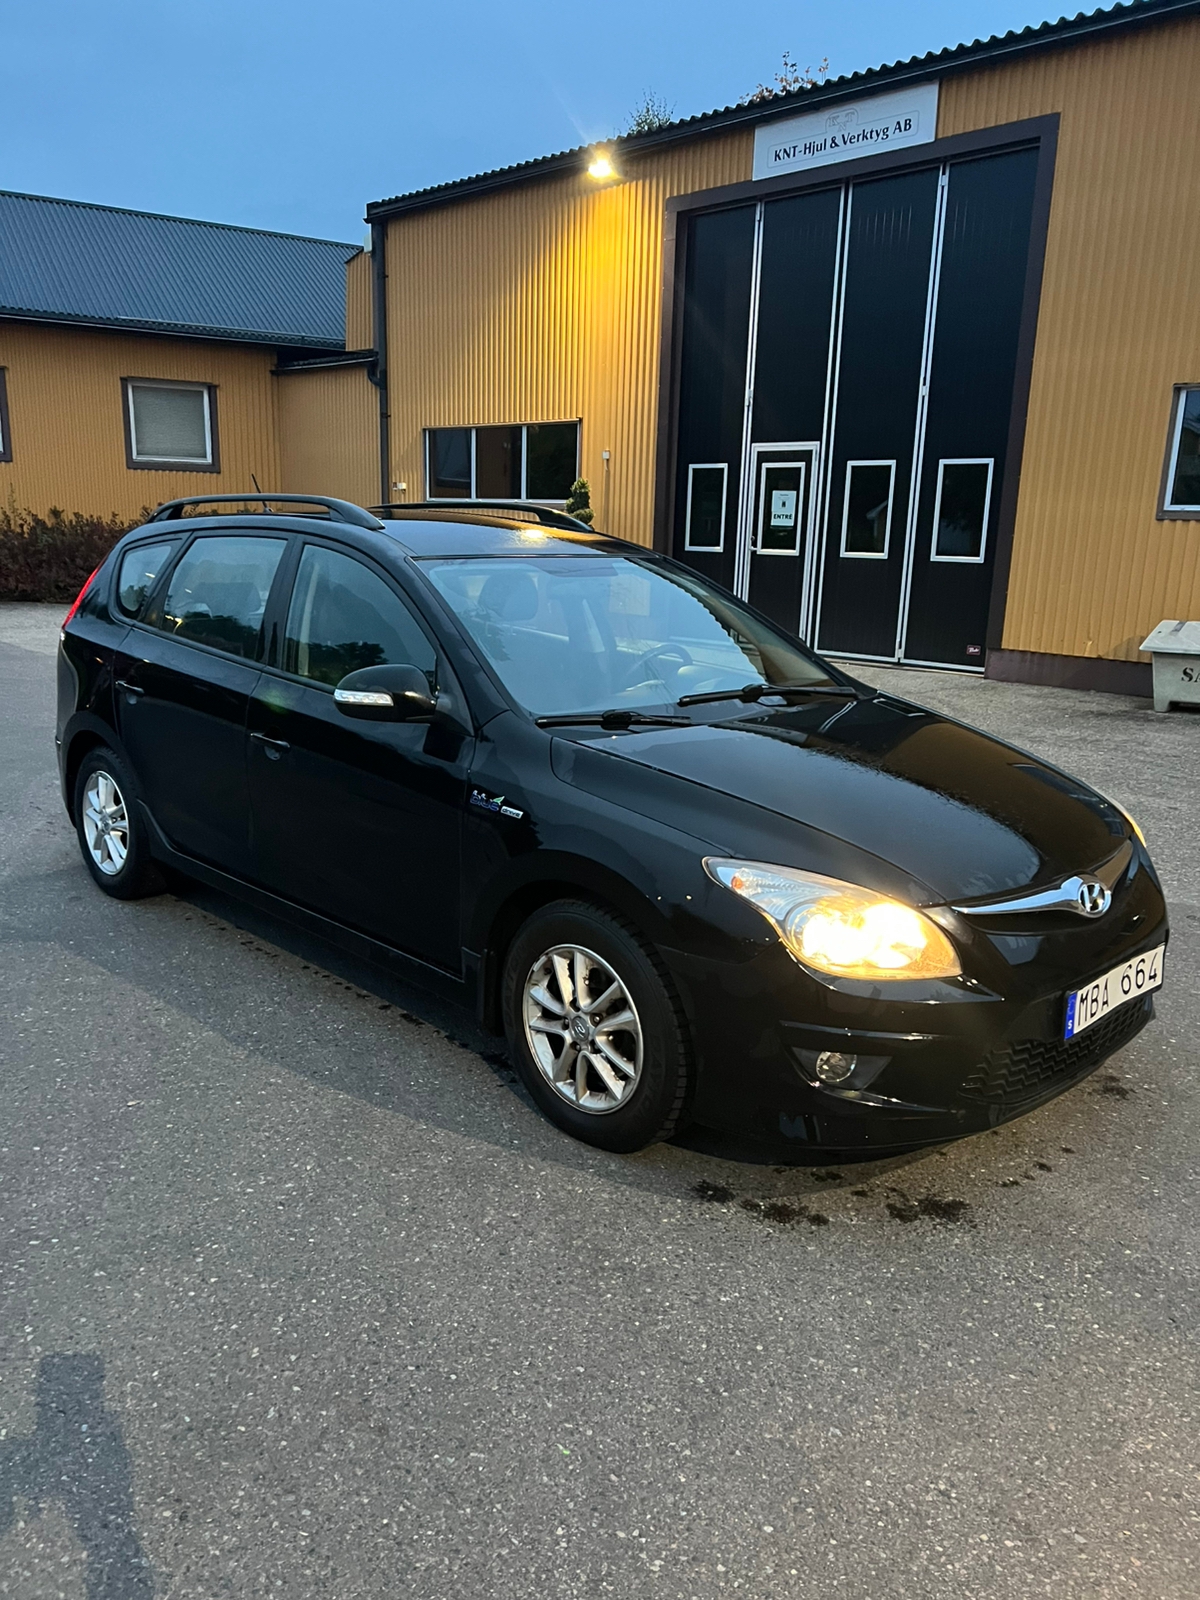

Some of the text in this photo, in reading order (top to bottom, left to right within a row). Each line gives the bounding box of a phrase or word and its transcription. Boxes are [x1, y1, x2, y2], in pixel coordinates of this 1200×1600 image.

[774, 118, 912, 162] KNT-Hjul & Verktyg AB
[1078, 952, 1158, 1026] MBA 664
[1067, 1020, 1073, 1030] S
